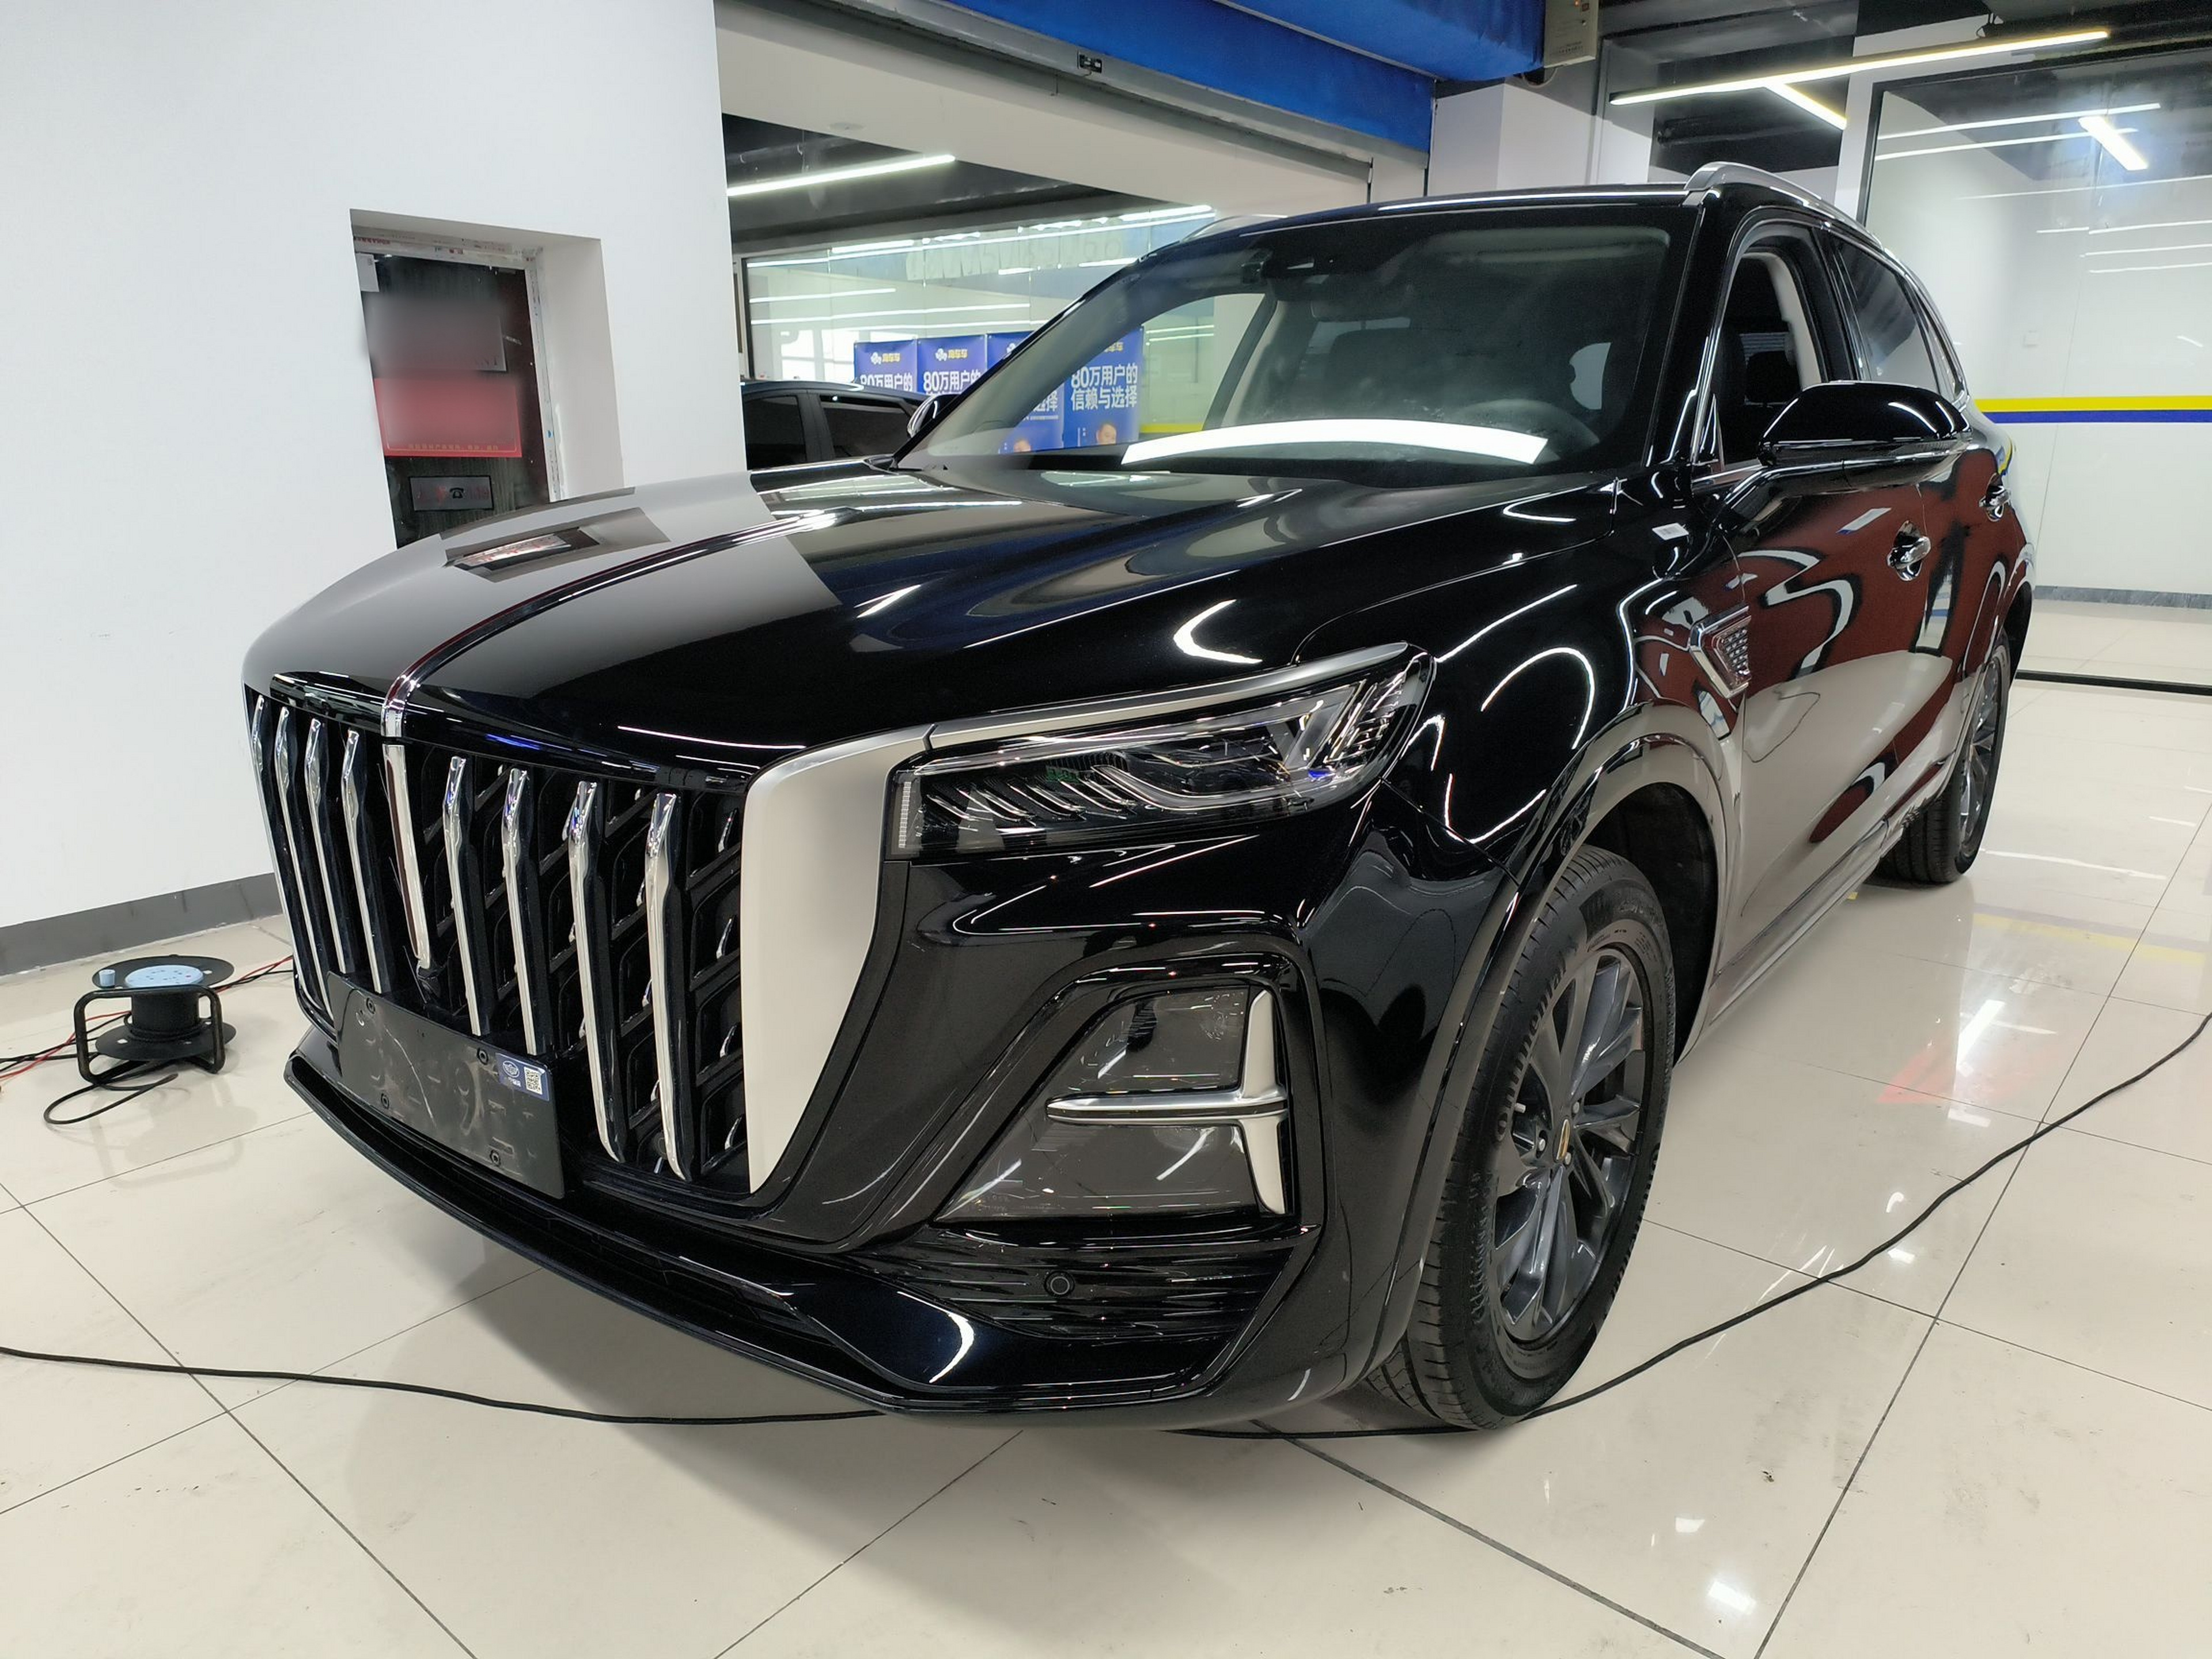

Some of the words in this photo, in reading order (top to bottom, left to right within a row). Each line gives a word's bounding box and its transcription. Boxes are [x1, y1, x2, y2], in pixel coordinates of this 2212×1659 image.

[1071, 362, 1138, 389] 80万用户的
[1070, 384, 1138, 411] 信赖与选择
